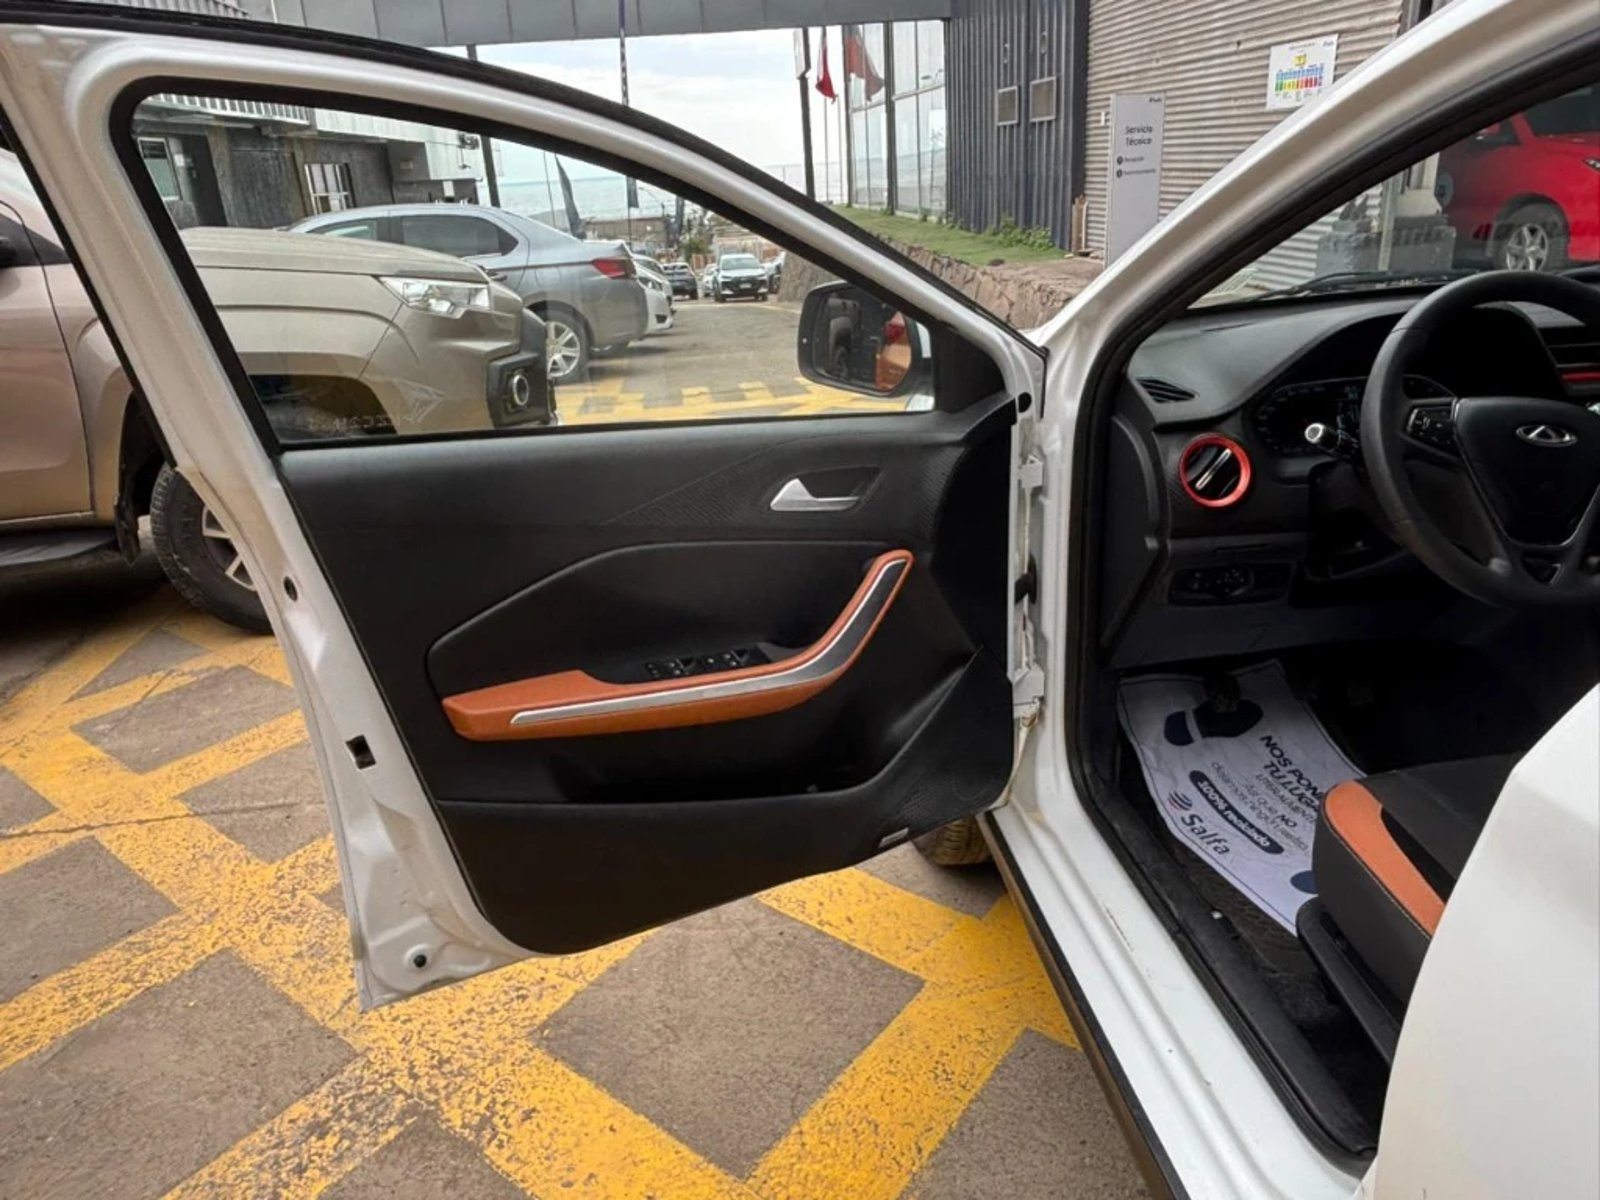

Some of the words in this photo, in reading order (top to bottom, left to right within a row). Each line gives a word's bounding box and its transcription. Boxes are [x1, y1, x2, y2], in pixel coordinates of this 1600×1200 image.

[1260, 735, 1293, 768] NOS
[1263, 760, 1287, 779] TU
[1197, 780, 1228, 811] 100%
[1181, 813, 1230, 855] Salfa
[1275, 813, 1298, 828] NO
